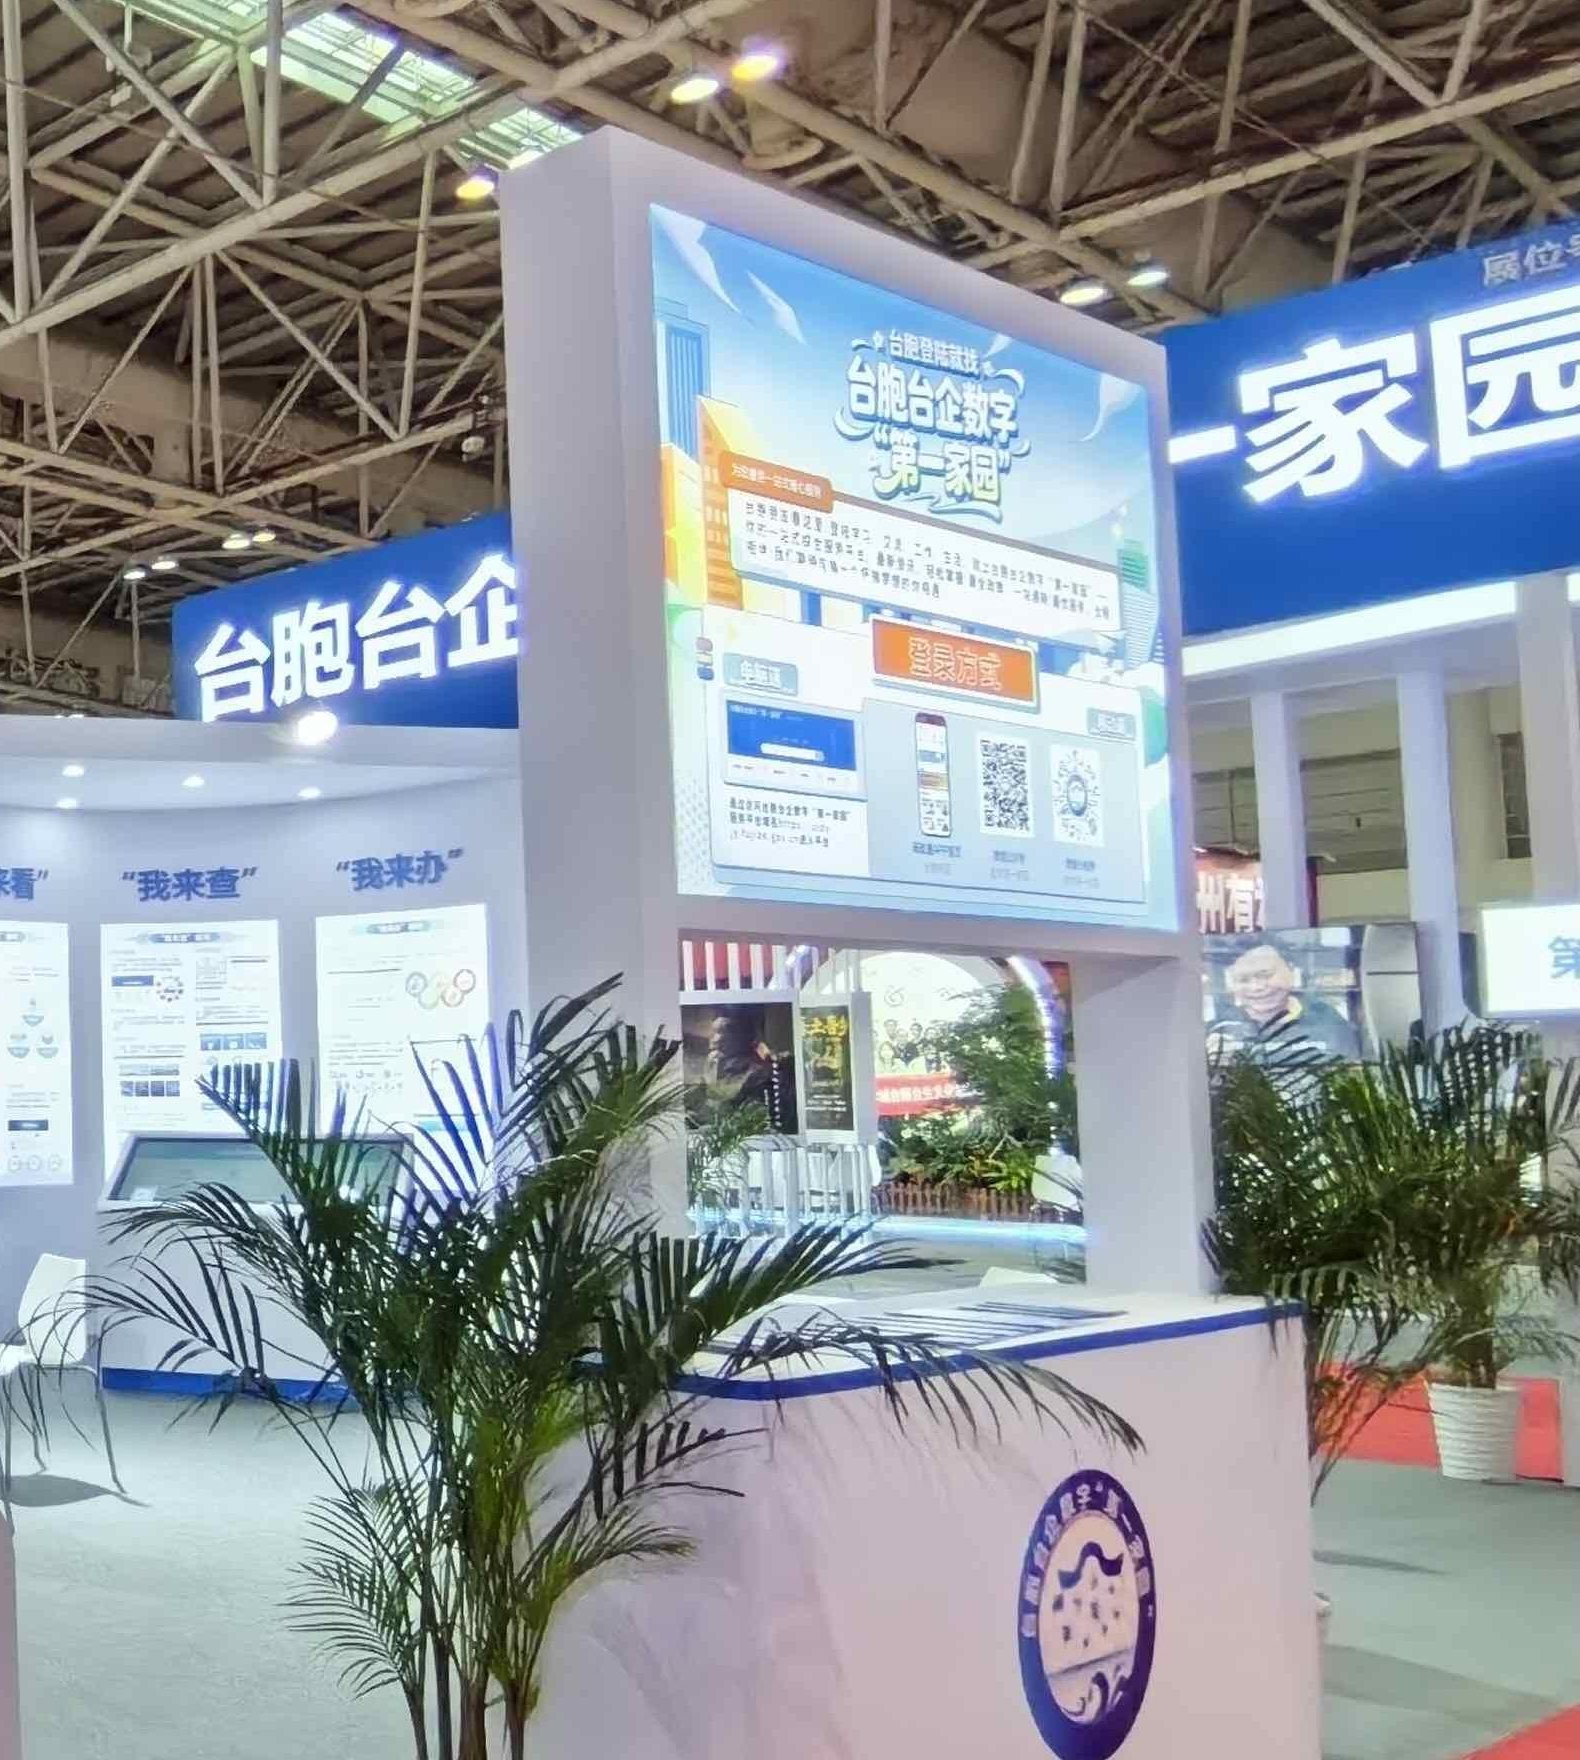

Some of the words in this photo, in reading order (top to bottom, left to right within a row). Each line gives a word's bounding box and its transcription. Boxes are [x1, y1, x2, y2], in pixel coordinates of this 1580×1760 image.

[848, 354, 1018, 444] 台胞台企数字
[194, 553, 519, 724] 台胞台企
[122, 866, 258, 902] “我来查”
[336, 848, 464, 891] “我来办”
